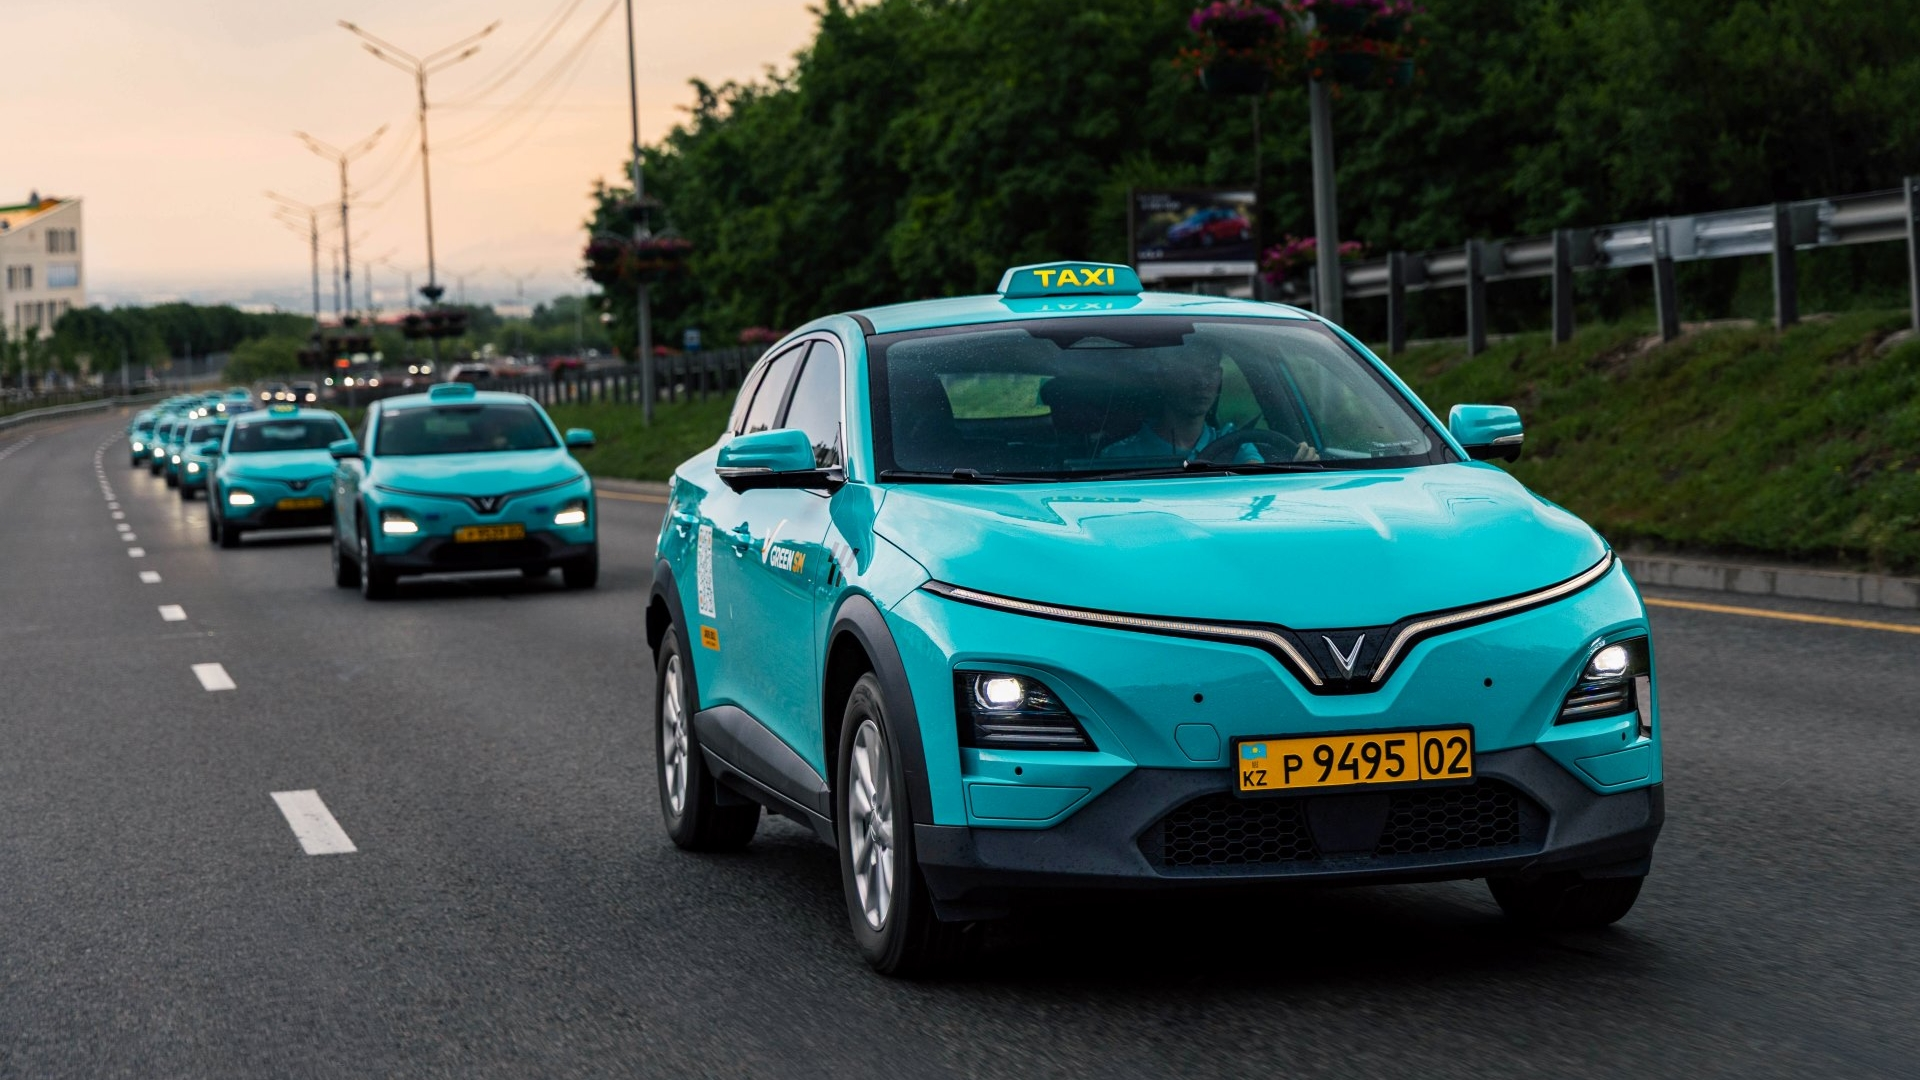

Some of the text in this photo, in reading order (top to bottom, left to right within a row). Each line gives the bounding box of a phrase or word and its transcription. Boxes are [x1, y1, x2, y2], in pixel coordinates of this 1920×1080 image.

[1033, 268, 1115, 288] TAXI
[770, 545, 806, 575] GREEN SM
[1283, 736, 1469, 784] P 9495 02
[1243, 769, 1268, 787] KZ
